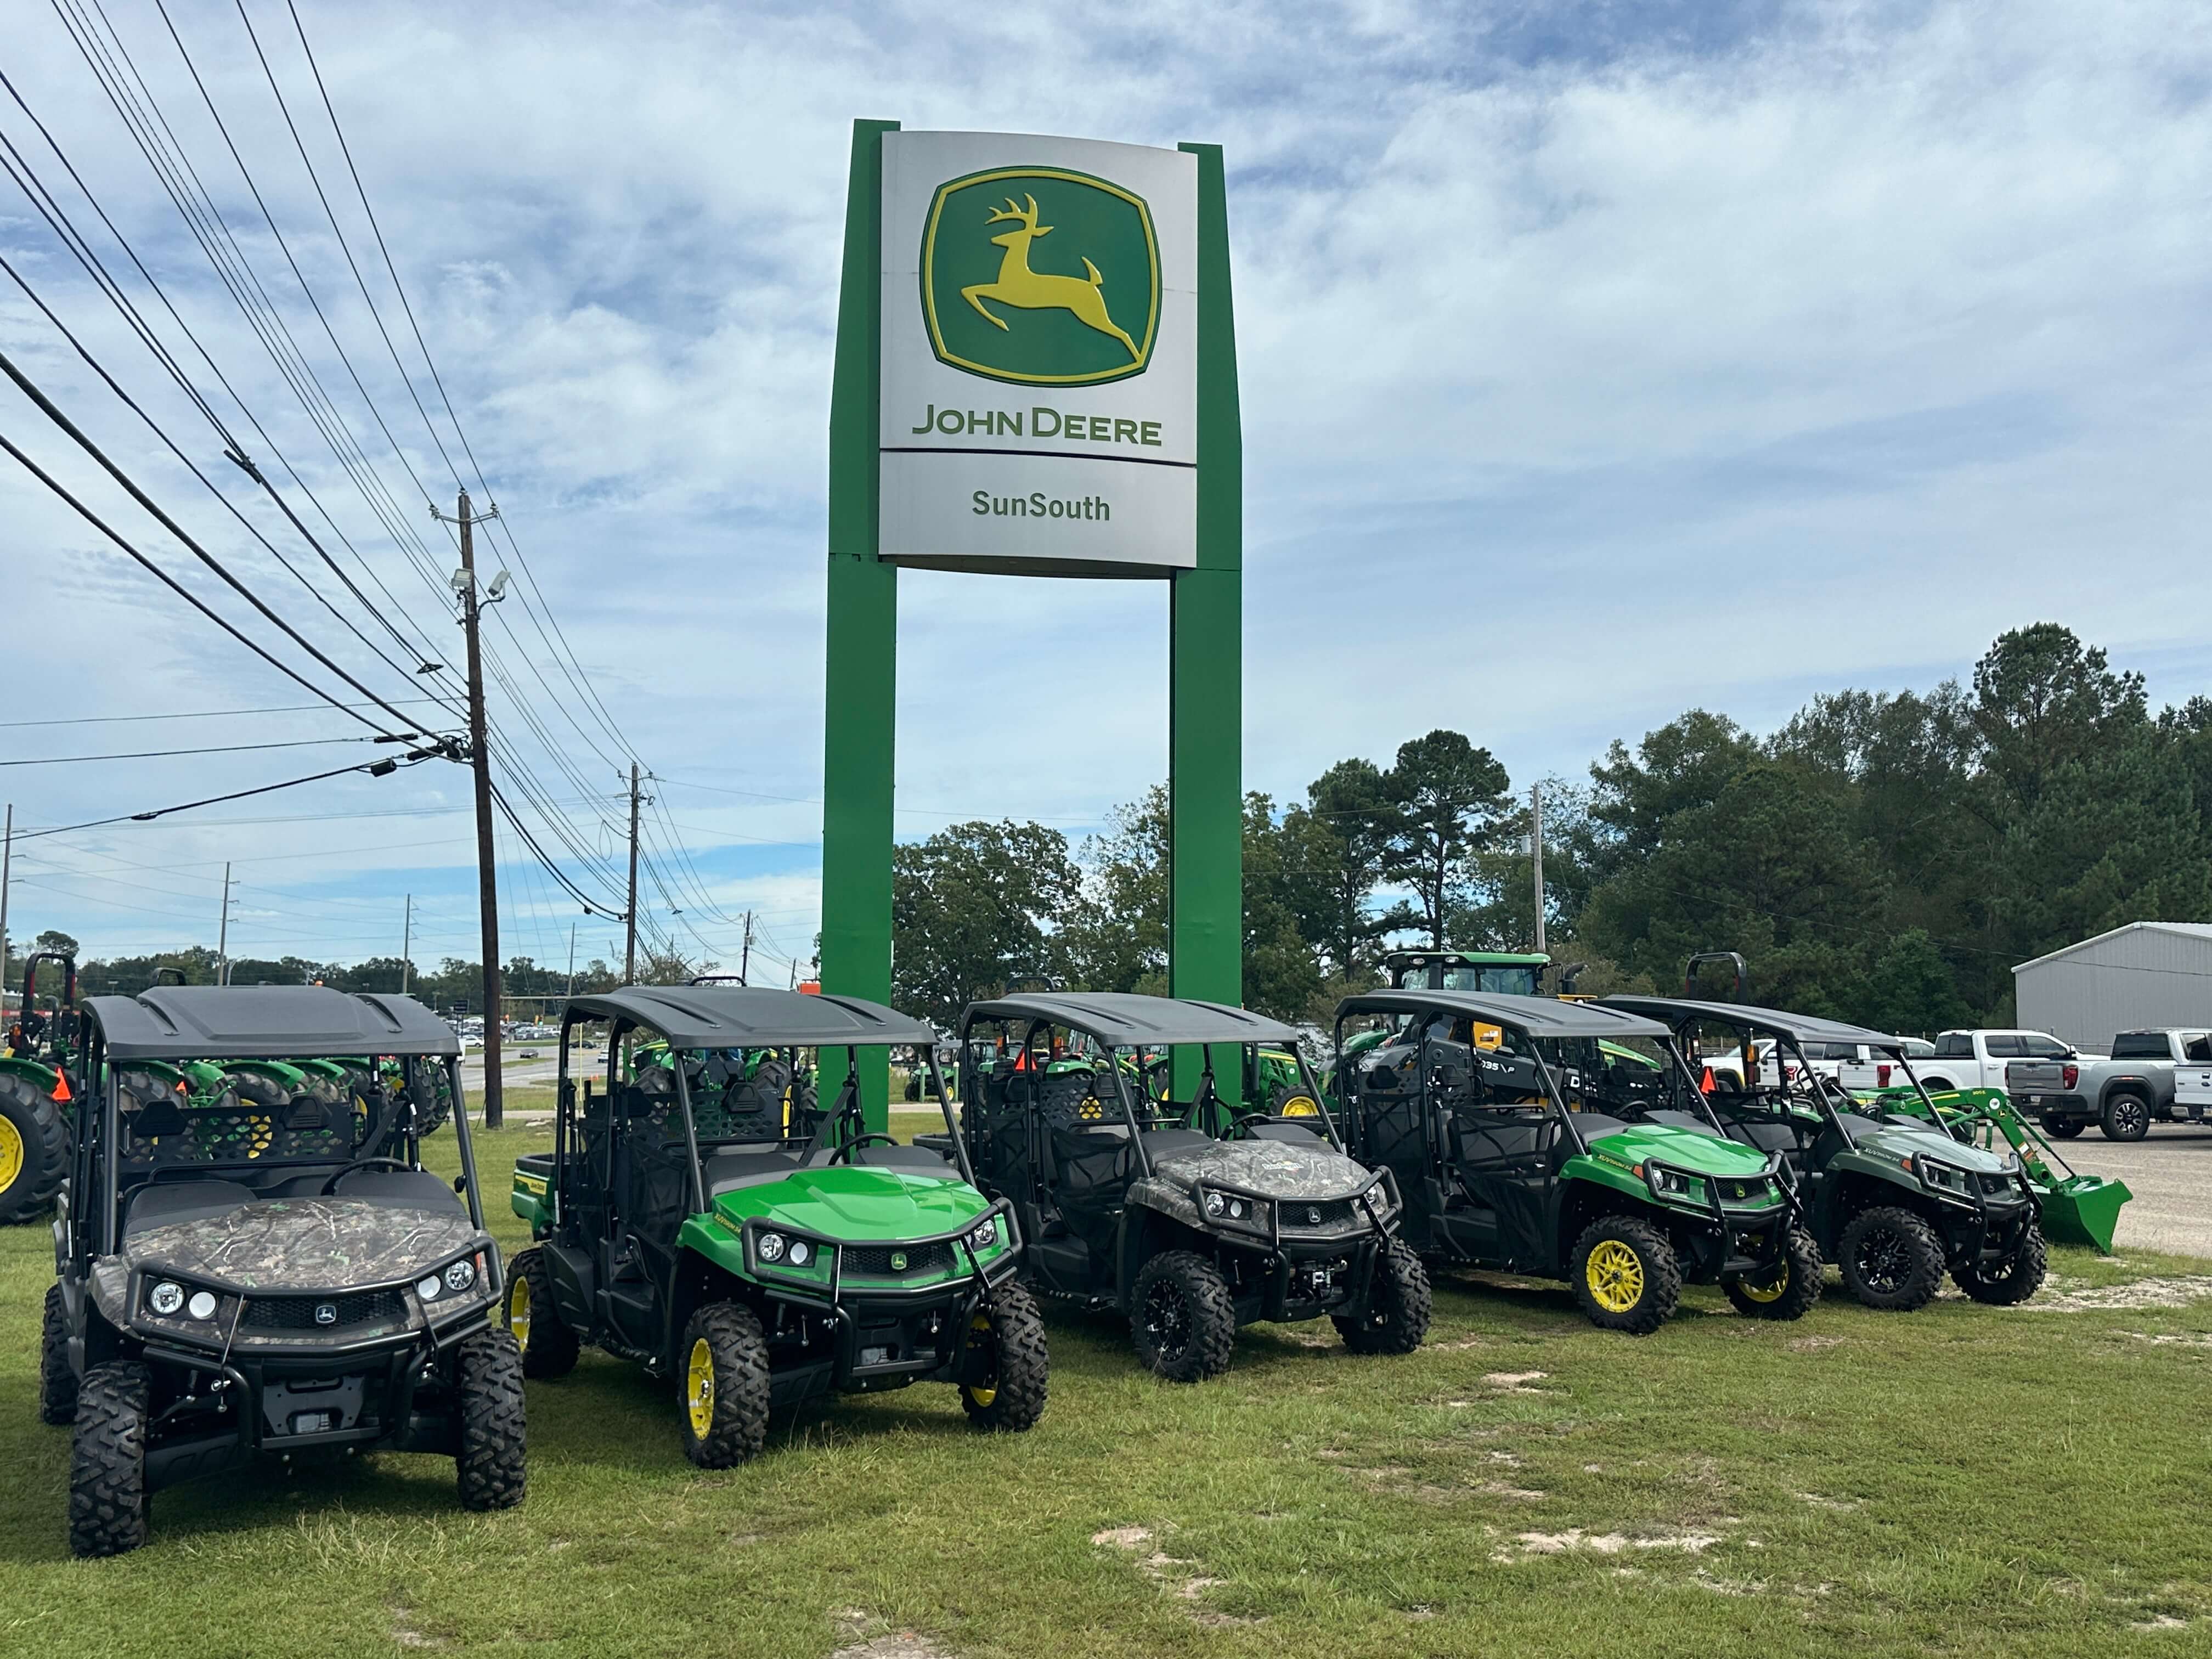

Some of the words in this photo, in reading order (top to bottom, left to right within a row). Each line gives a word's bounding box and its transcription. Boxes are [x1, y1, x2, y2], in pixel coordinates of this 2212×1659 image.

[912, 404, 1023, 436] JOHN
[1032, 407, 1162, 447] DEERE
[972, 491, 1110, 521] SunSouth
